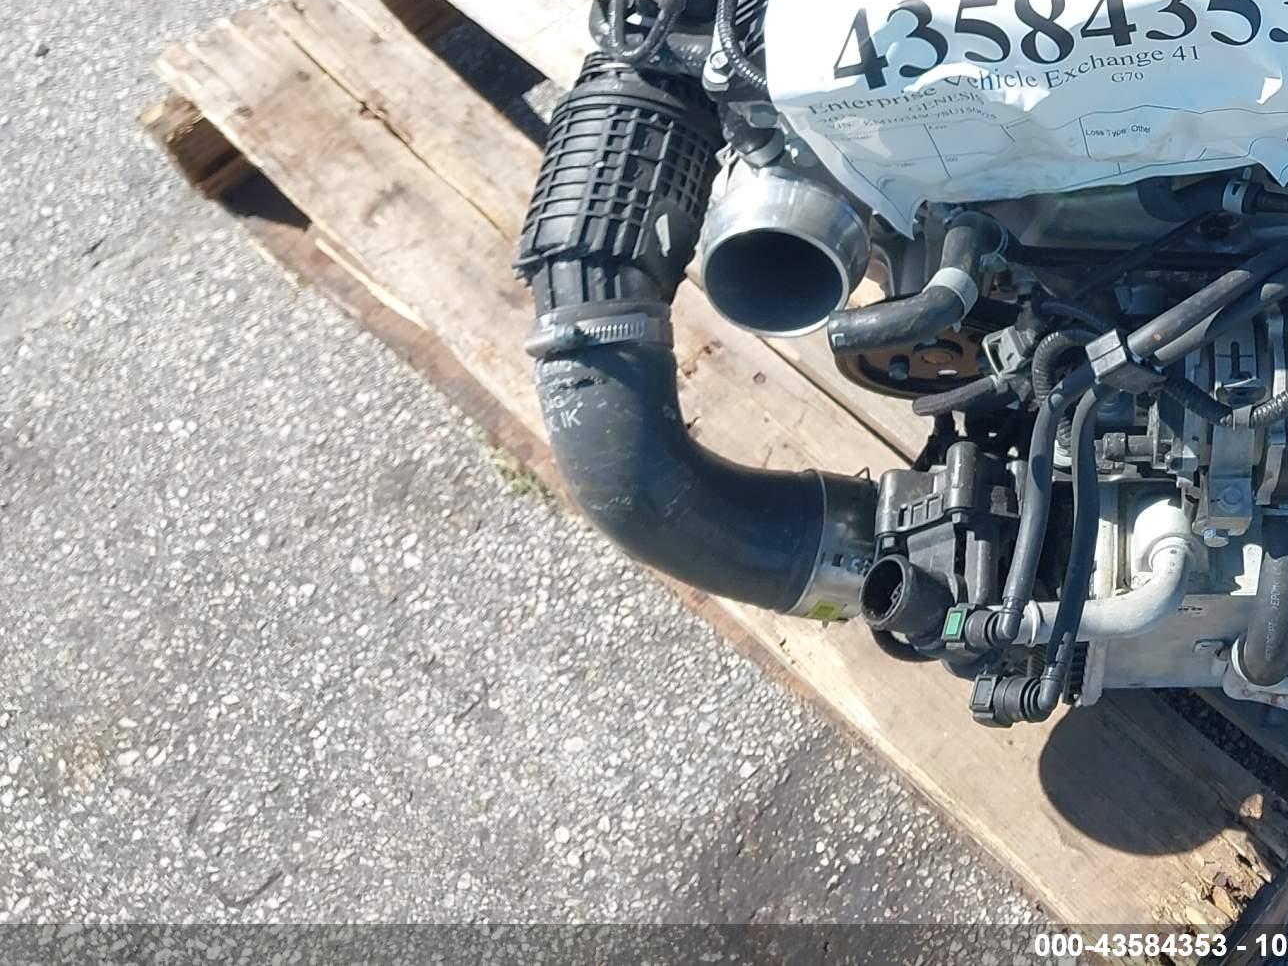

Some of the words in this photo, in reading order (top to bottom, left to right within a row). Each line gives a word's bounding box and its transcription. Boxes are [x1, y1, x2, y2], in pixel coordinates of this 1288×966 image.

[808, 87, 937, 116] Enterprise
[1046, 48, 1164, 90] Exchange
[1172, 44, 1200, 61] 41
[1111, 70, 1144, 83] G70
[1131, 124, 1152, 134] Other
